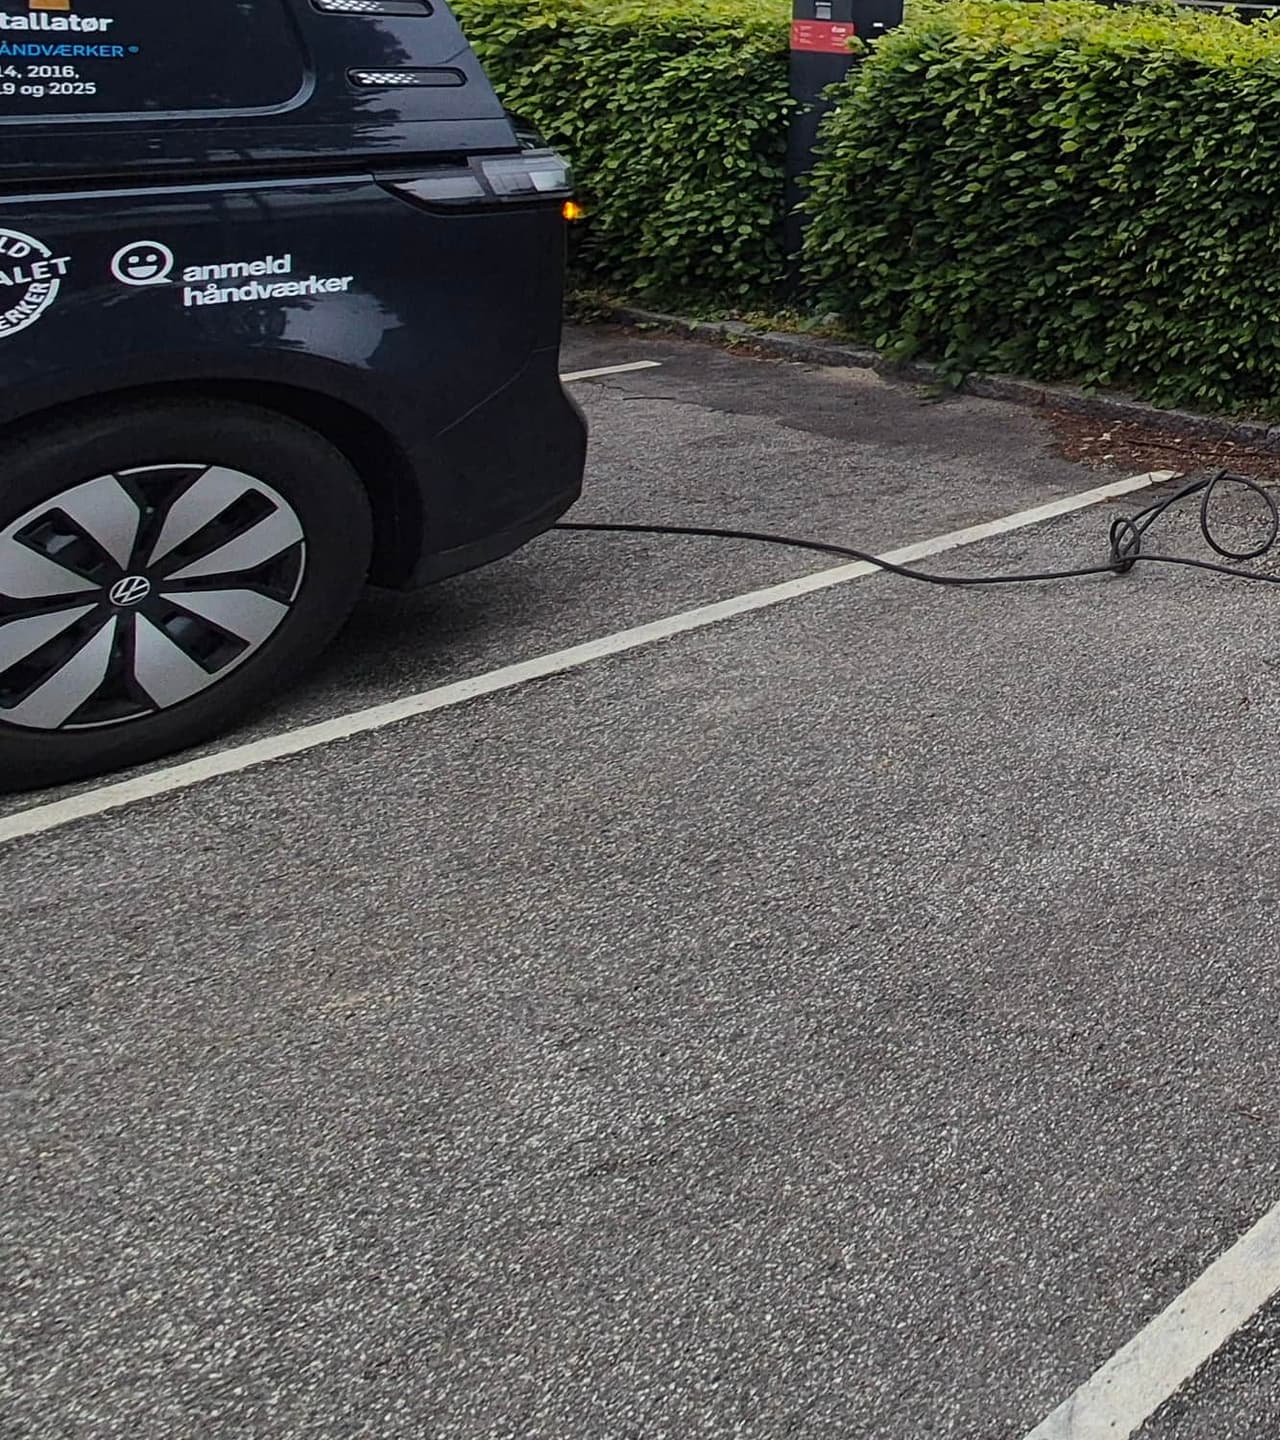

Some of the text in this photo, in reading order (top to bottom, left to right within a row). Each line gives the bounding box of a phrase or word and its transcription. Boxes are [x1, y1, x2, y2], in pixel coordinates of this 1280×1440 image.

[0, 12, 114, 32] tallatør
[27, 65, 80, 79] 2016,
[0, 82, 97, 98] 9 og 2025
[182, 254, 291, 282] anmeld
[183, 275, 354, 307] håndværker
